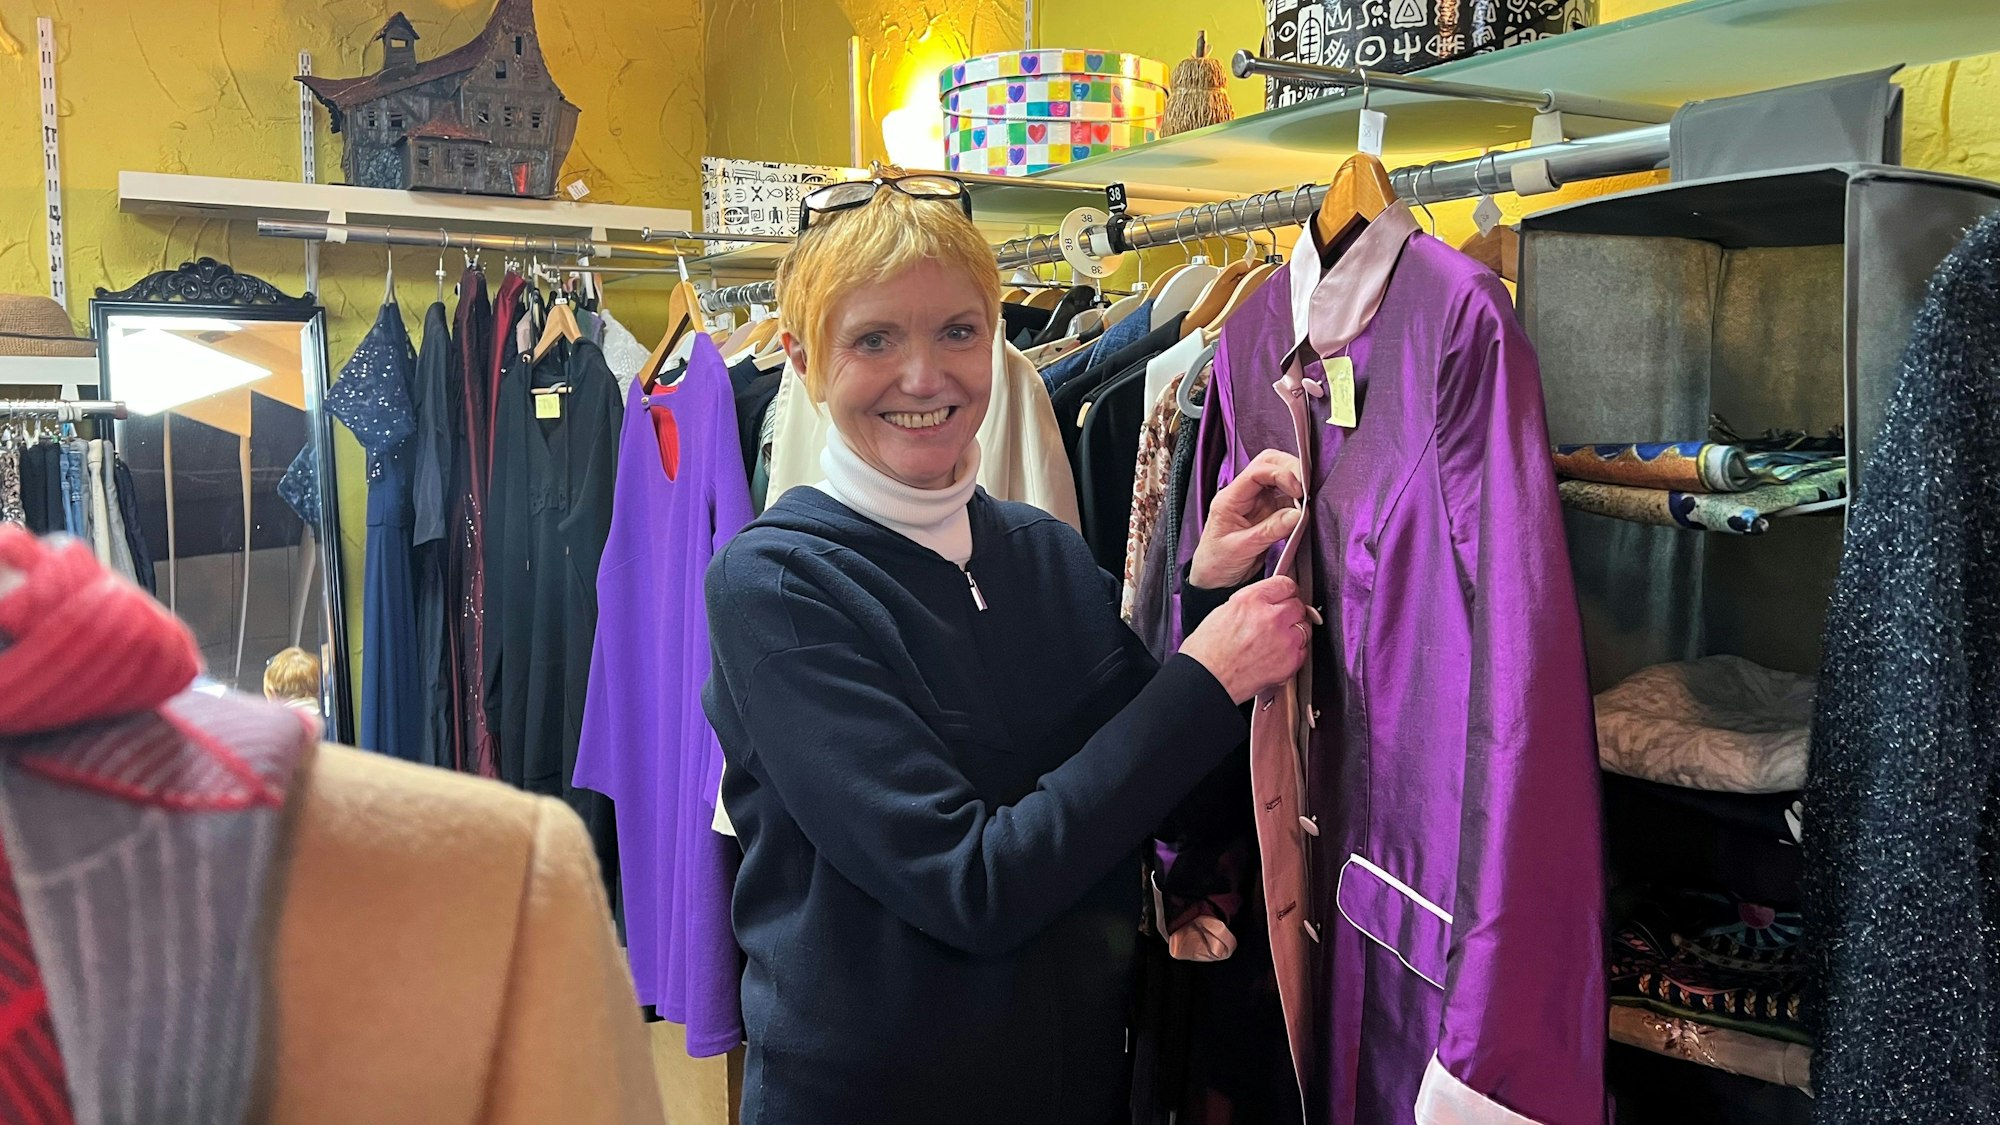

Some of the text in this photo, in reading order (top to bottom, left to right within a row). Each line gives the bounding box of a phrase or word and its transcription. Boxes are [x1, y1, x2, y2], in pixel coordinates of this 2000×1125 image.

[1109, 187, 1121, 201] 38
[1081, 214, 1093, 222] 38
[1065, 238, 1073, 251] 38
[1091, 266, 1103, 274] 38
